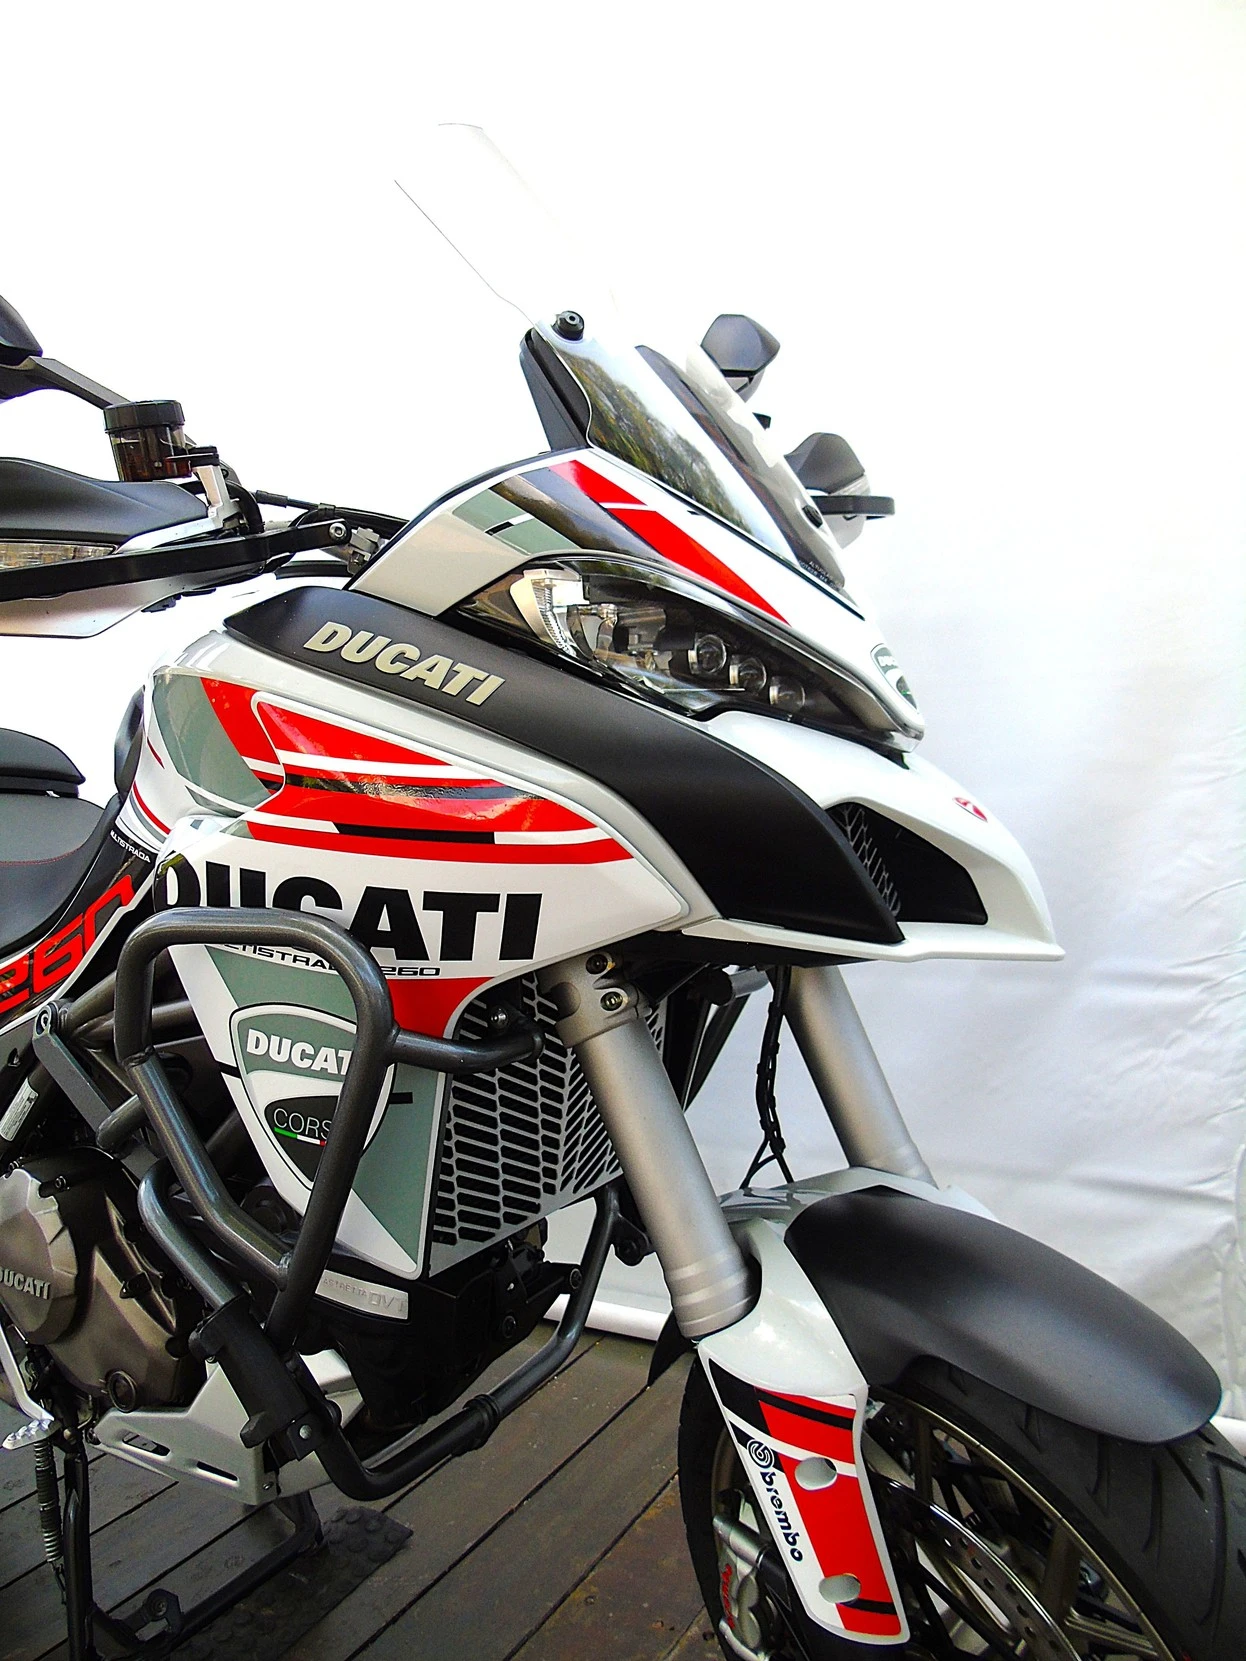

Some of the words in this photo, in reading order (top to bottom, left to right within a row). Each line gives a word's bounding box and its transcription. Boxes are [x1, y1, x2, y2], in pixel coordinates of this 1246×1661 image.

[304, 620, 505, 706] DUCATI
[246, 1028, 353, 1076] DUCAT
[273, 1108, 332, 1140] CORS
[760, 1471, 804, 1562] brembo
